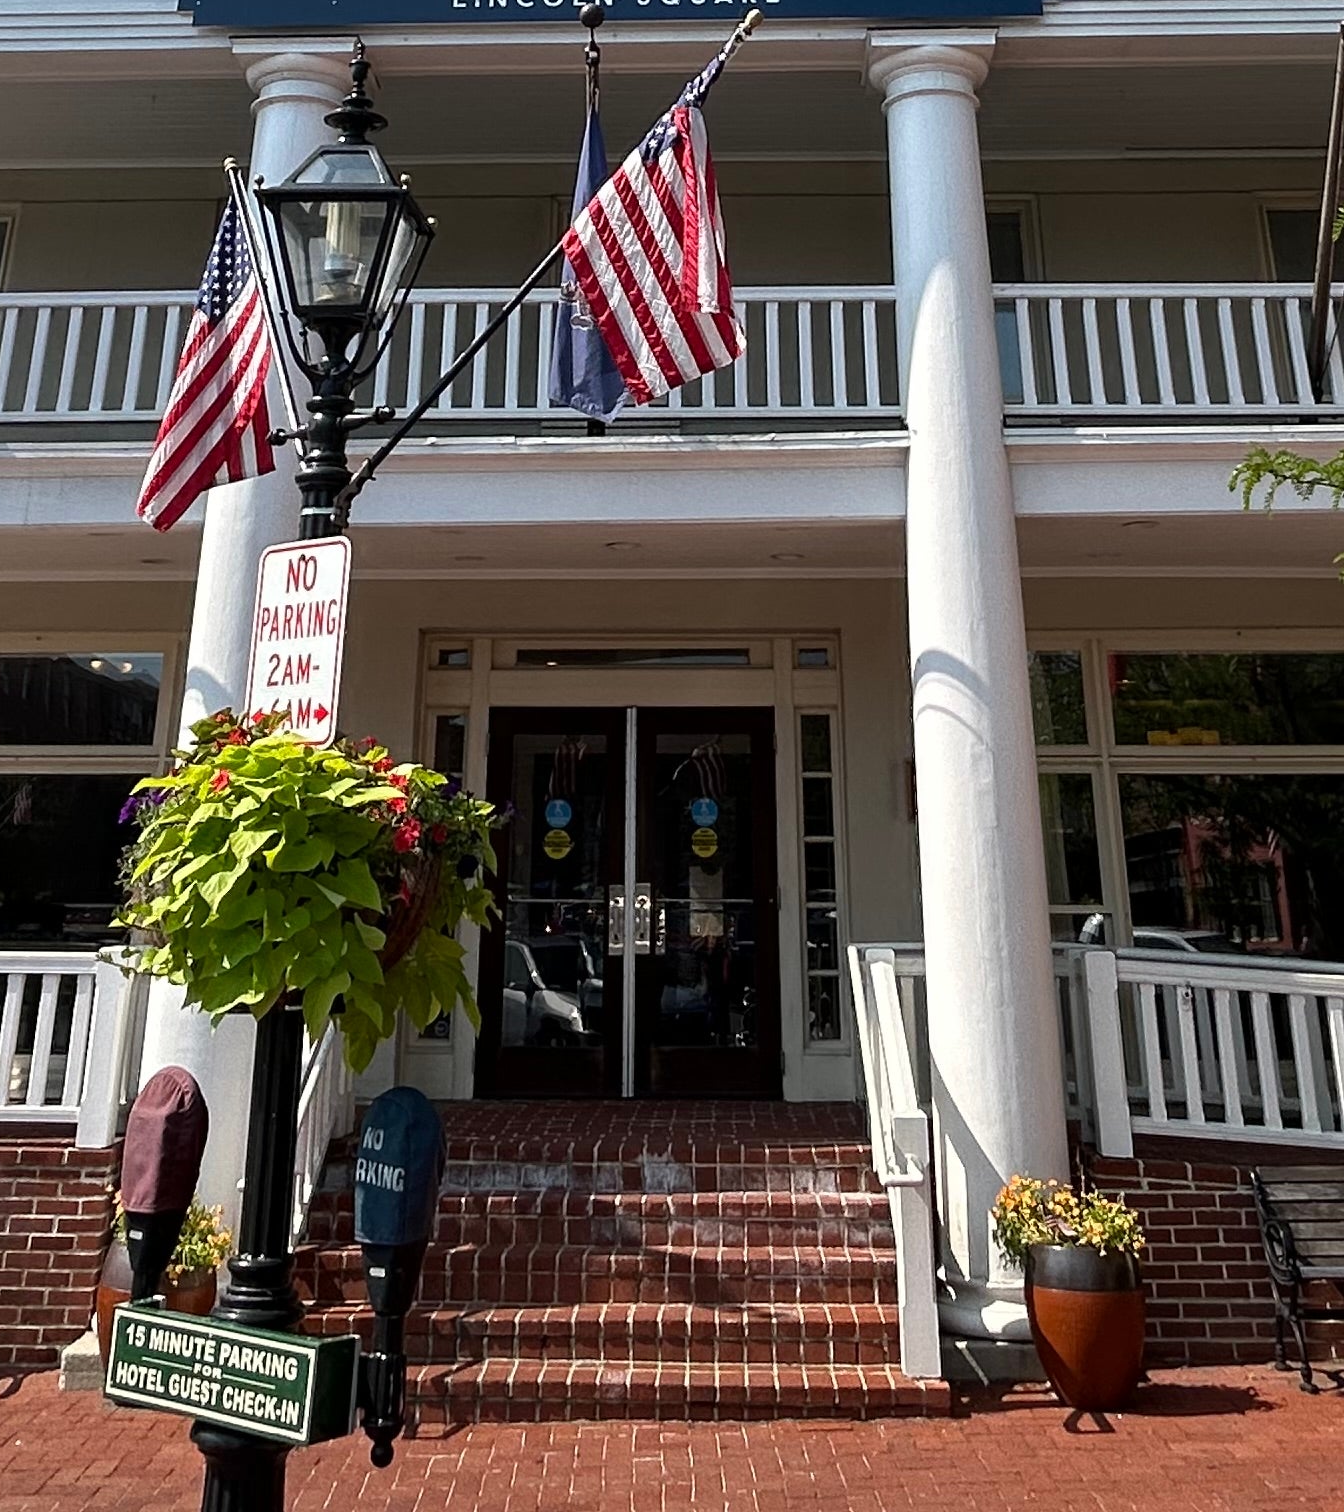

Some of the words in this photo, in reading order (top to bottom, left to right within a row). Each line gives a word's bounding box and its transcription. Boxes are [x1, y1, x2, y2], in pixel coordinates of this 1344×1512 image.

[285, 555, 318, 593] NO
[259, 599, 337, 641] PARKING
[266, 653, 320, 688] 2AM-
[363, 1126, 384, 1150] NO
[356, 1157, 405, 1191] RKING
[125, 1322, 147, 1348] 15
[148, 1327, 217, 1363] MINUTE
[218, 1341, 300, 1382] PARKING
[192, 1363, 223, 1381] FOR
[115, 1360, 166, 1396] HOTEL
[167, 1372, 221, 1407] GUEST
[221, 1384, 301, 1426] CHECK-IN
